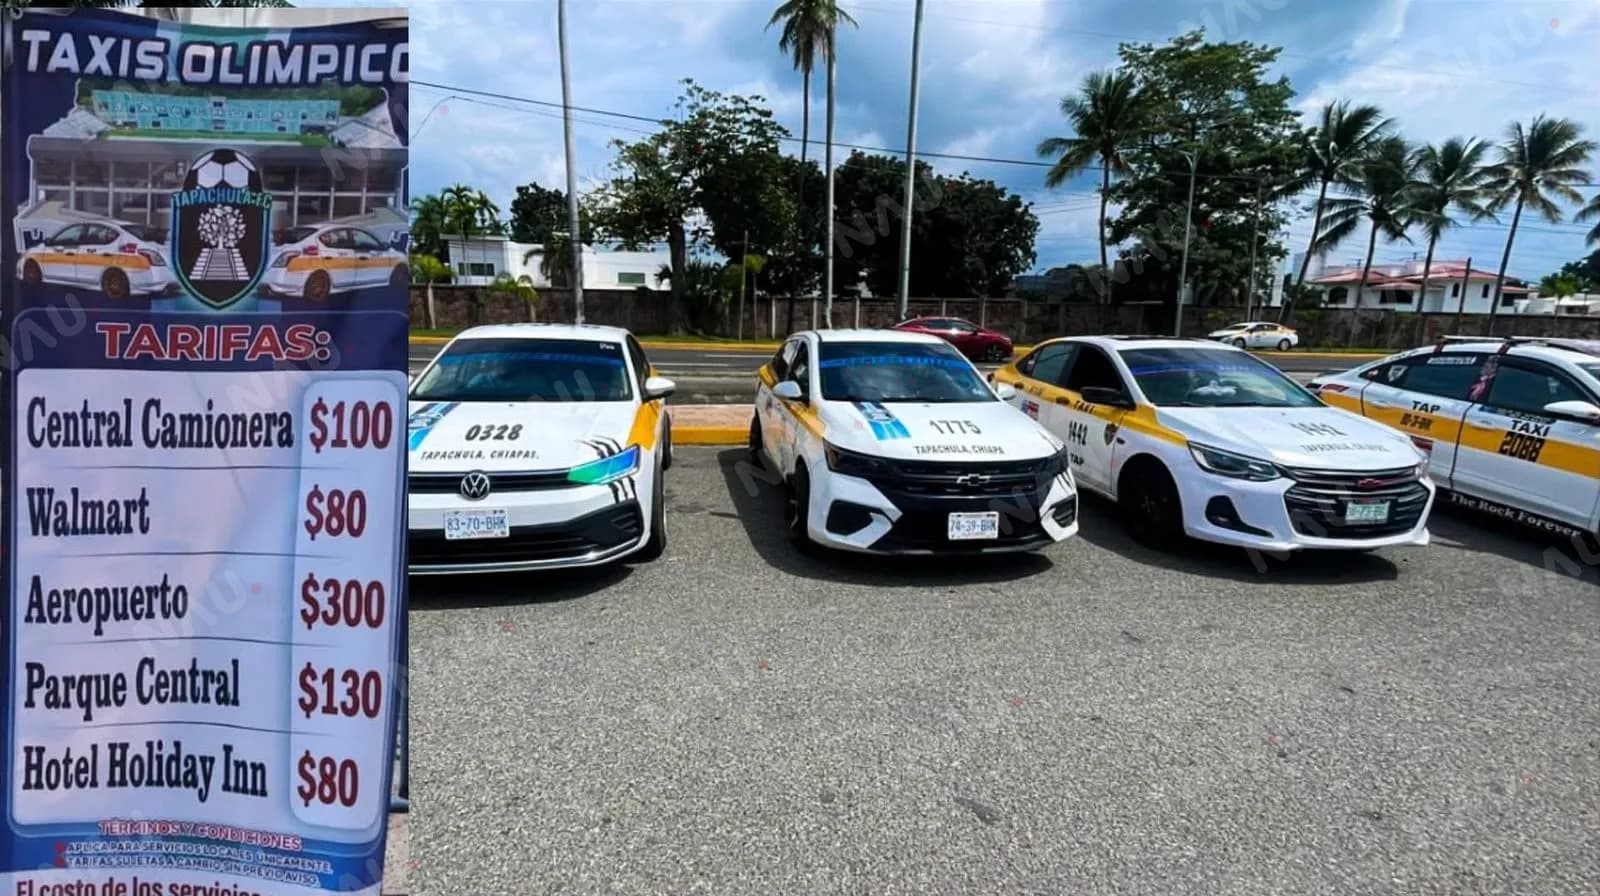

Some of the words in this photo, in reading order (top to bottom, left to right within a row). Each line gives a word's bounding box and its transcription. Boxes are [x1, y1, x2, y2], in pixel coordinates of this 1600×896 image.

[22, 30, 165, 80] TAXIS
[96, 322, 331, 361] TARIFAS:
[1412, 400, 1441, 414] TAP
[27, 397, 133, 448] Central
[142, 398, 293, 448] Camionera
[310, 397, 392, 453] $100
[464, 424, 523, 441] 0328
[929, 419, 981, 434] 1775
[1069, 420, 1088, 446] 1442
[1511, 419, 1550, 437] TAXI
[1497, 431, 1546, 462] 2088
[26, 487, 150, 536] Walmart
[304, 485, 366, 540] $80
[1449, 492, 1476, 507] The
[1478, 501, 1515, 519] Rock
[1517, 511, 1581, 537] Forever
[24, 573, 188, 636] Aeropuerto
[301, 573, 385, 630] $300
[24, 662, 127, 721] Parque
[136, 657, 240, 707] Central
[298, 662, 382, 718] $130
[23, 744, 98, 790] Hotel
[107, 739, 215, 802] Holiday
[222, 744, 268, 797] Inn
[297, 750, 358, 807] $80
[68, 841, 107, 854] APLICA
[110, 841, 141, 854] PARA
[142, 842, 201, 855] SERVICIOS
[203, 845, 253, 861] LOCALES
[181, 821, 196, 836] Y
[198, 824, 302, 850] CONDICIONES
[16, 880, 34, 896] El
[40, 879, 97, 896] costo
[102, 876, 128, 896] de
[132, 876, 164, 896] los
